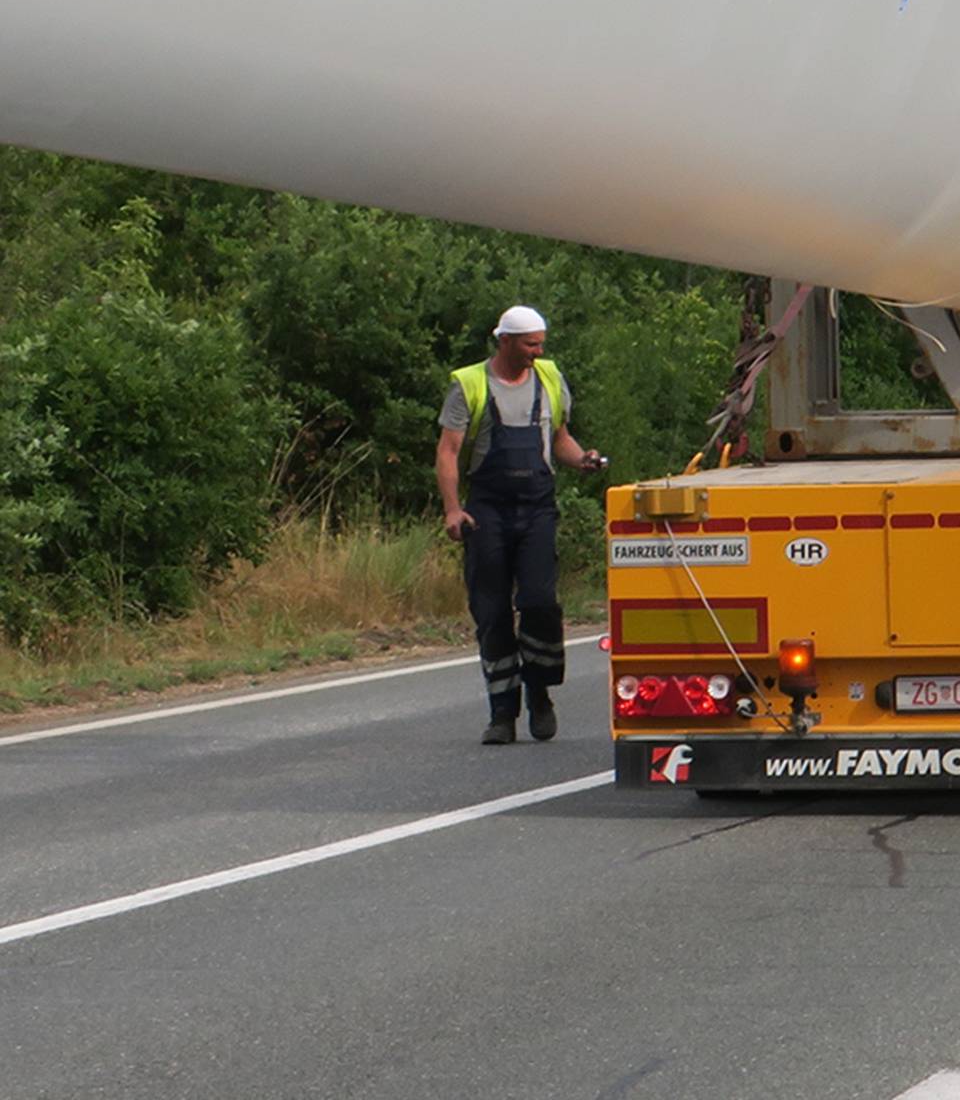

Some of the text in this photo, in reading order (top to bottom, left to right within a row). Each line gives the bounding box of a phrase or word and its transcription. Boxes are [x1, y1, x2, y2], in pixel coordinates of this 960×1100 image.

[614, 545, 674, 559] FAHRZEUG
[721, 543, 745, 557] AUS
[789, 543, 824, 560] HR
[911, 681, 938, 706] ZG
